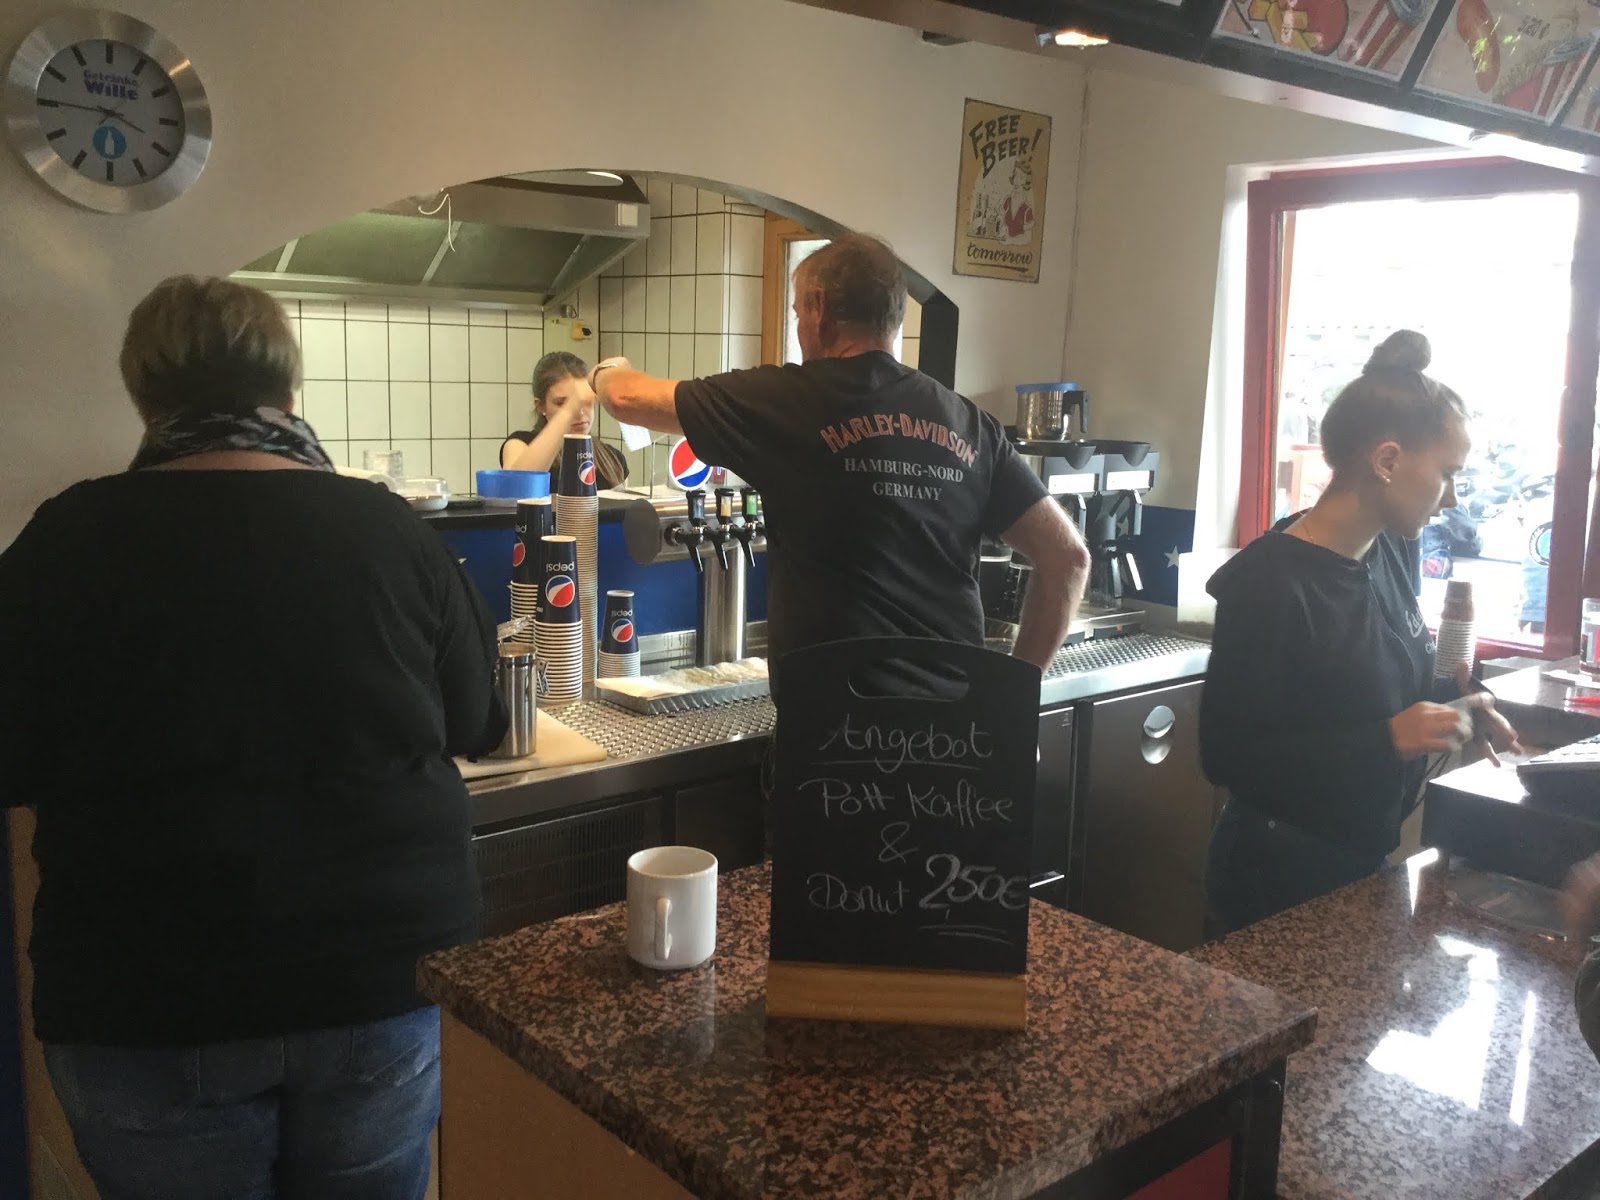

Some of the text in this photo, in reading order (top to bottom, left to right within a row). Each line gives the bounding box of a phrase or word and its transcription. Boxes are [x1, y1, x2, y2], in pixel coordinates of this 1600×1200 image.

[969, 115, 1021, 160] FREE
[980, 128, 1043, 180] BEER!
[967, 241, 1033, 266] tomorrow
[820, 412, 978, 469] HARLEY-DAVIDSON
[844, 457, 964, 483] HAMBURG-NORD
[872, 481, 943, 501] GERMANY
[545, 561, 575, 573] pepsi
[611, 608, 633, 617] pepsi
[819, 713, 992, 773] Angebot
[798, 778, 1013, 828] Pott Kaffee
[878, 821, 919, 863] &
[806, 872, 910, 915] Donut
